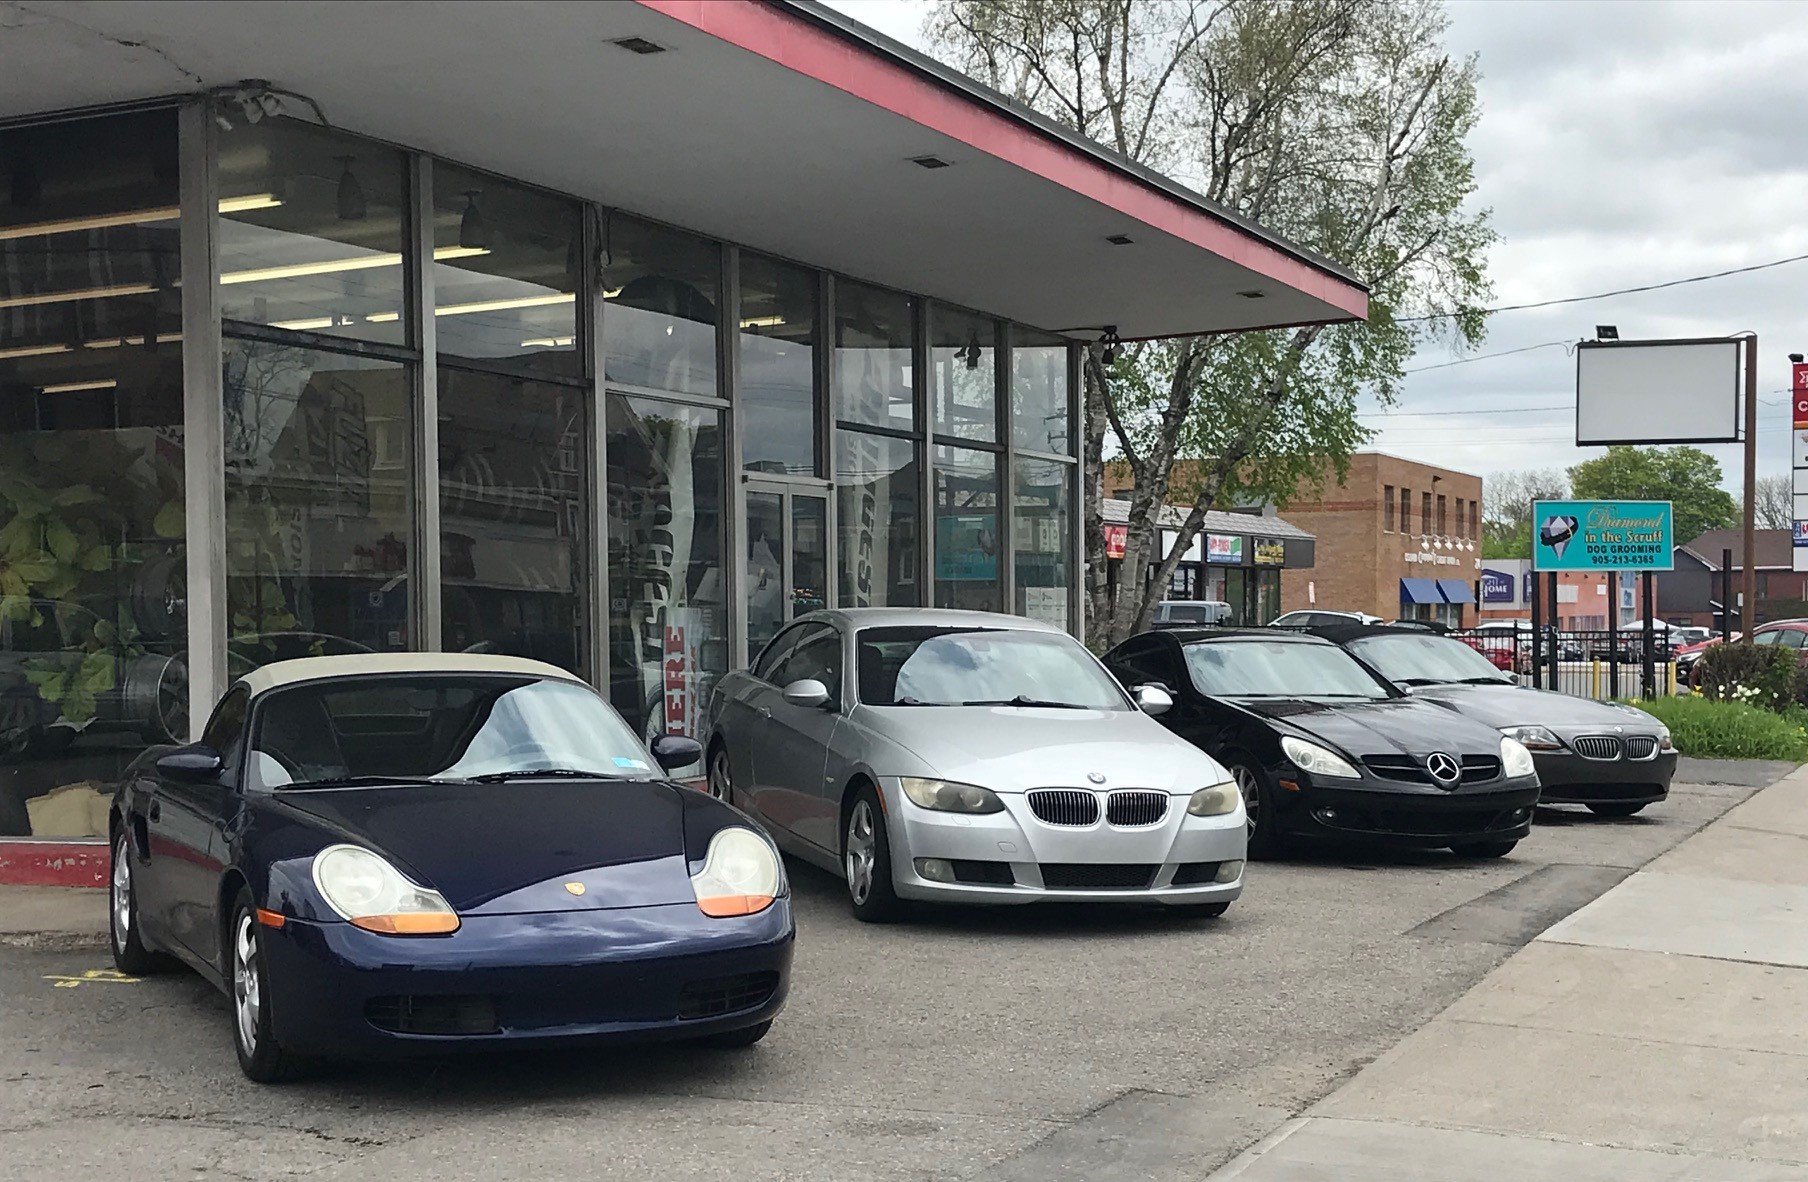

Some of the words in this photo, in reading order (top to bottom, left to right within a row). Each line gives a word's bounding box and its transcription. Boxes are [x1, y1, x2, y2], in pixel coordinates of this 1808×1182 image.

[1585, 505, 1664, 529] Diamond
[1585, 530, 1597, 543] in
[1601, 530, 1621, 543] the
[1627, 530, 1663, 543] Scruff
[1587, 545, 1607, 554] DOG
[1610, 545, 1662, 554] GROOMING
